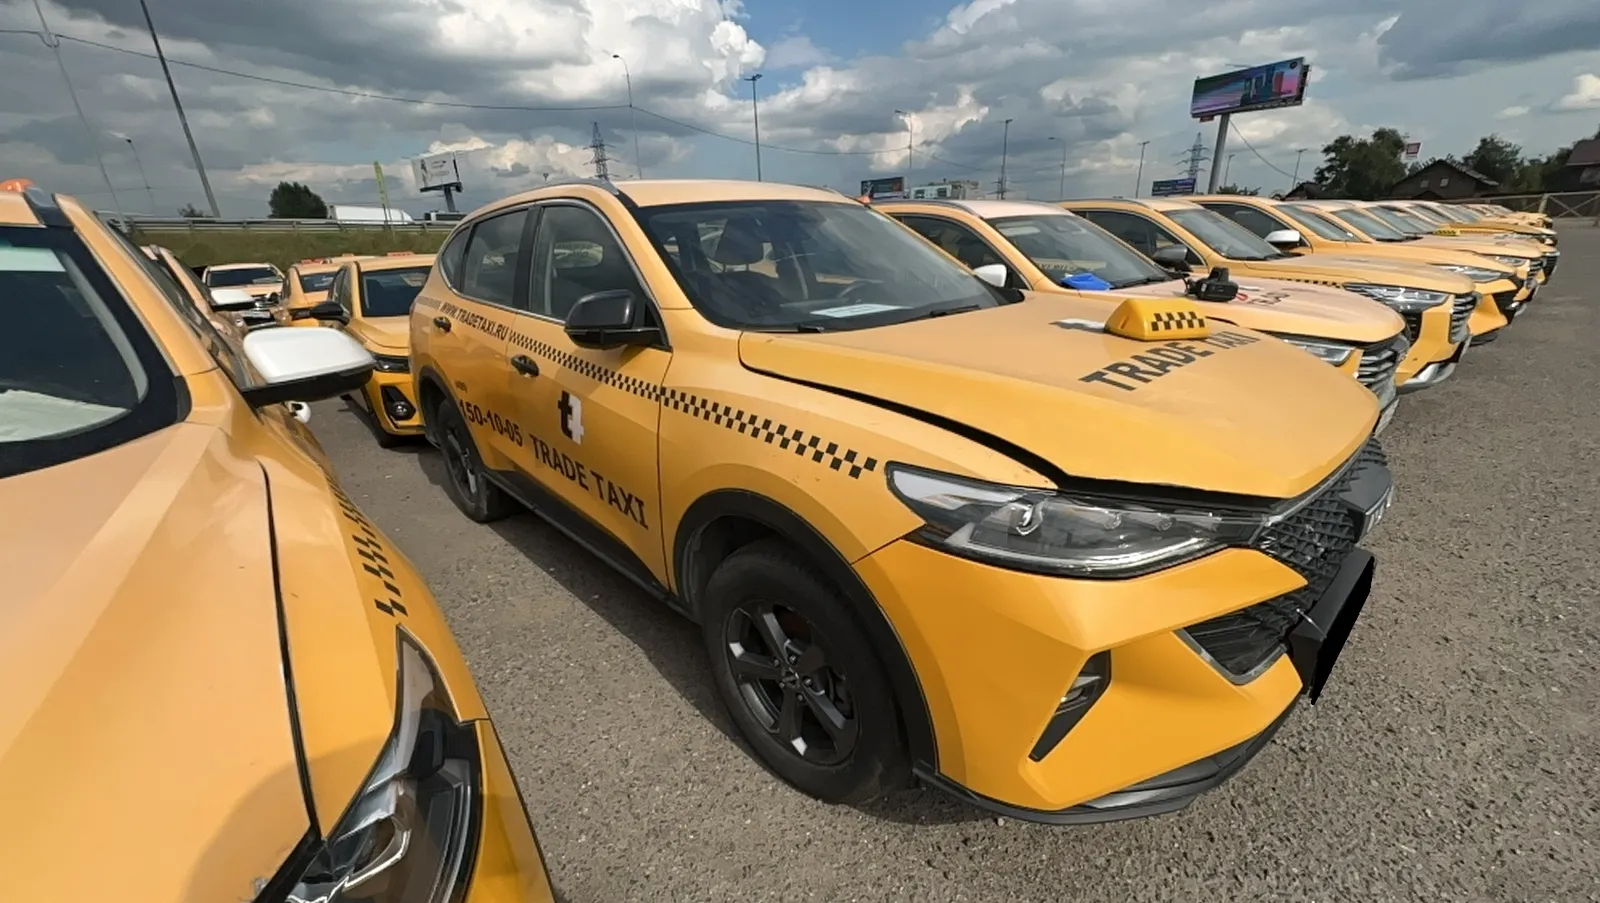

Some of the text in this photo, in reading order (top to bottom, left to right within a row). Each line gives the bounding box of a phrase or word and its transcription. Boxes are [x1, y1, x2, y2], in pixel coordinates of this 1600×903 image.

[1078, 341, 1215, 391] TRADE
[459, 398, 523, 447] 150-10-05
[529, 432, 649, 531] TRADE TAXI
